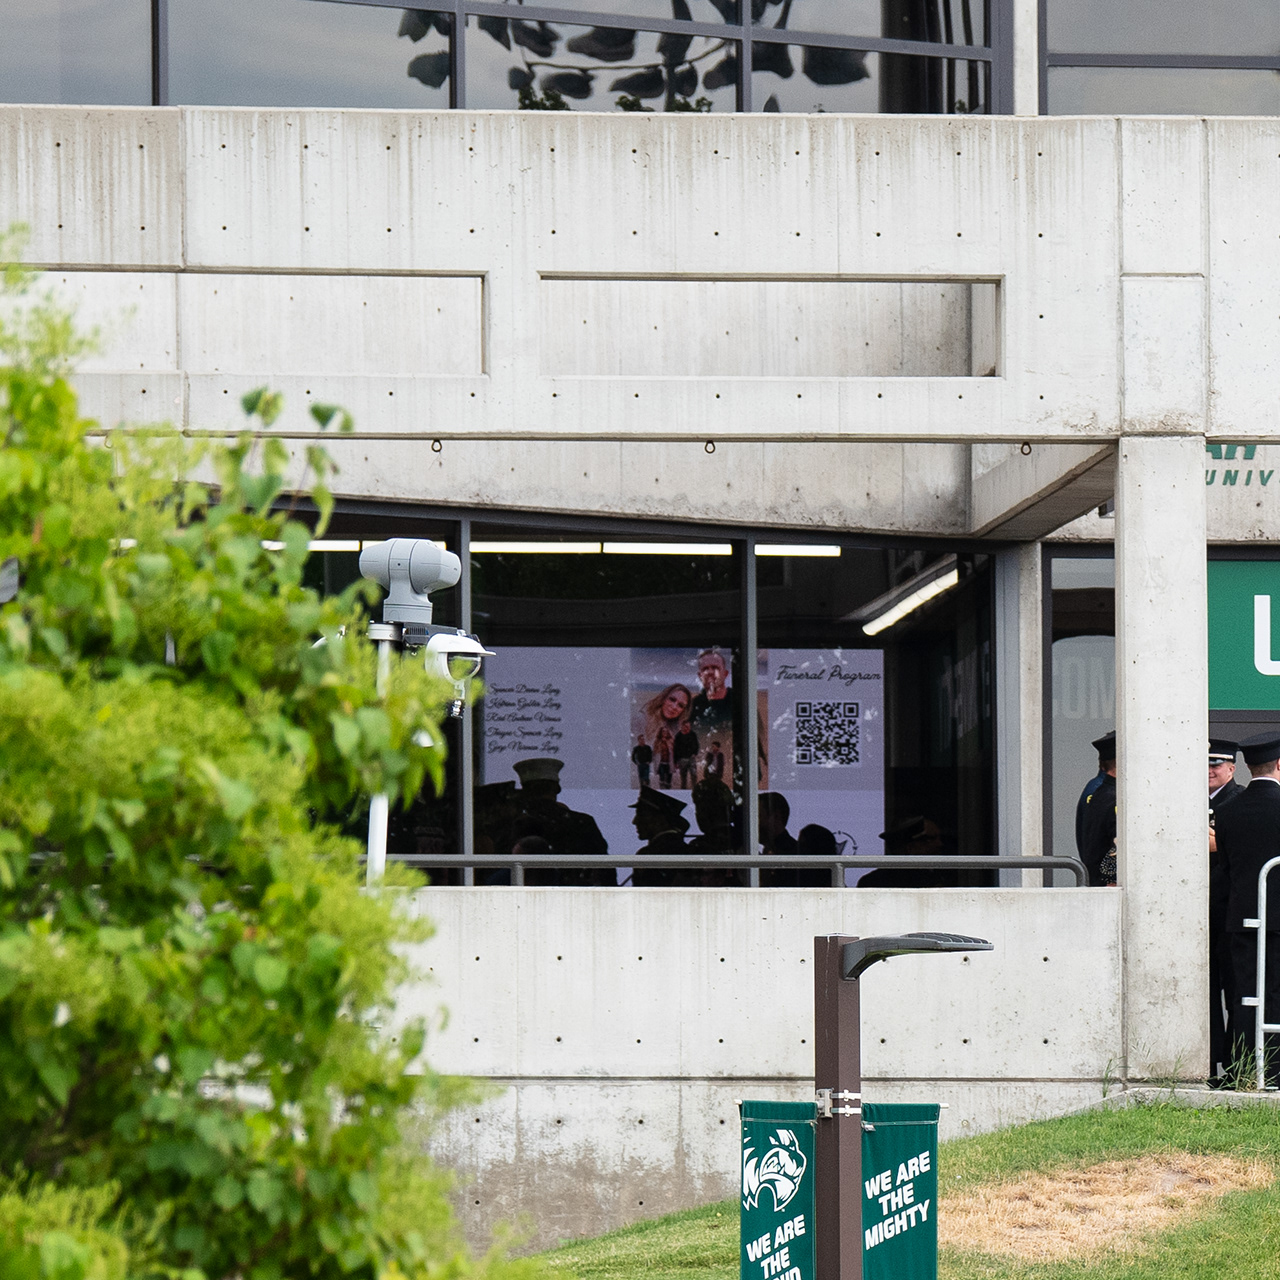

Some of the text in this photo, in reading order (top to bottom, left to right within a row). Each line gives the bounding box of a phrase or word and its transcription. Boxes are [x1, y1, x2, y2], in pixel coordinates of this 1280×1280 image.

[777, 664, 882, 687] Funeral Program
[864, 1150, 931, 1200] WE ARE
[878, 1182, 914, 1216] THE
[746, 1214, 806, 1263] WE ARE
[864, 1199, 930, 1250] MIGHTY
[760, 1246, 790, 1280] THE
